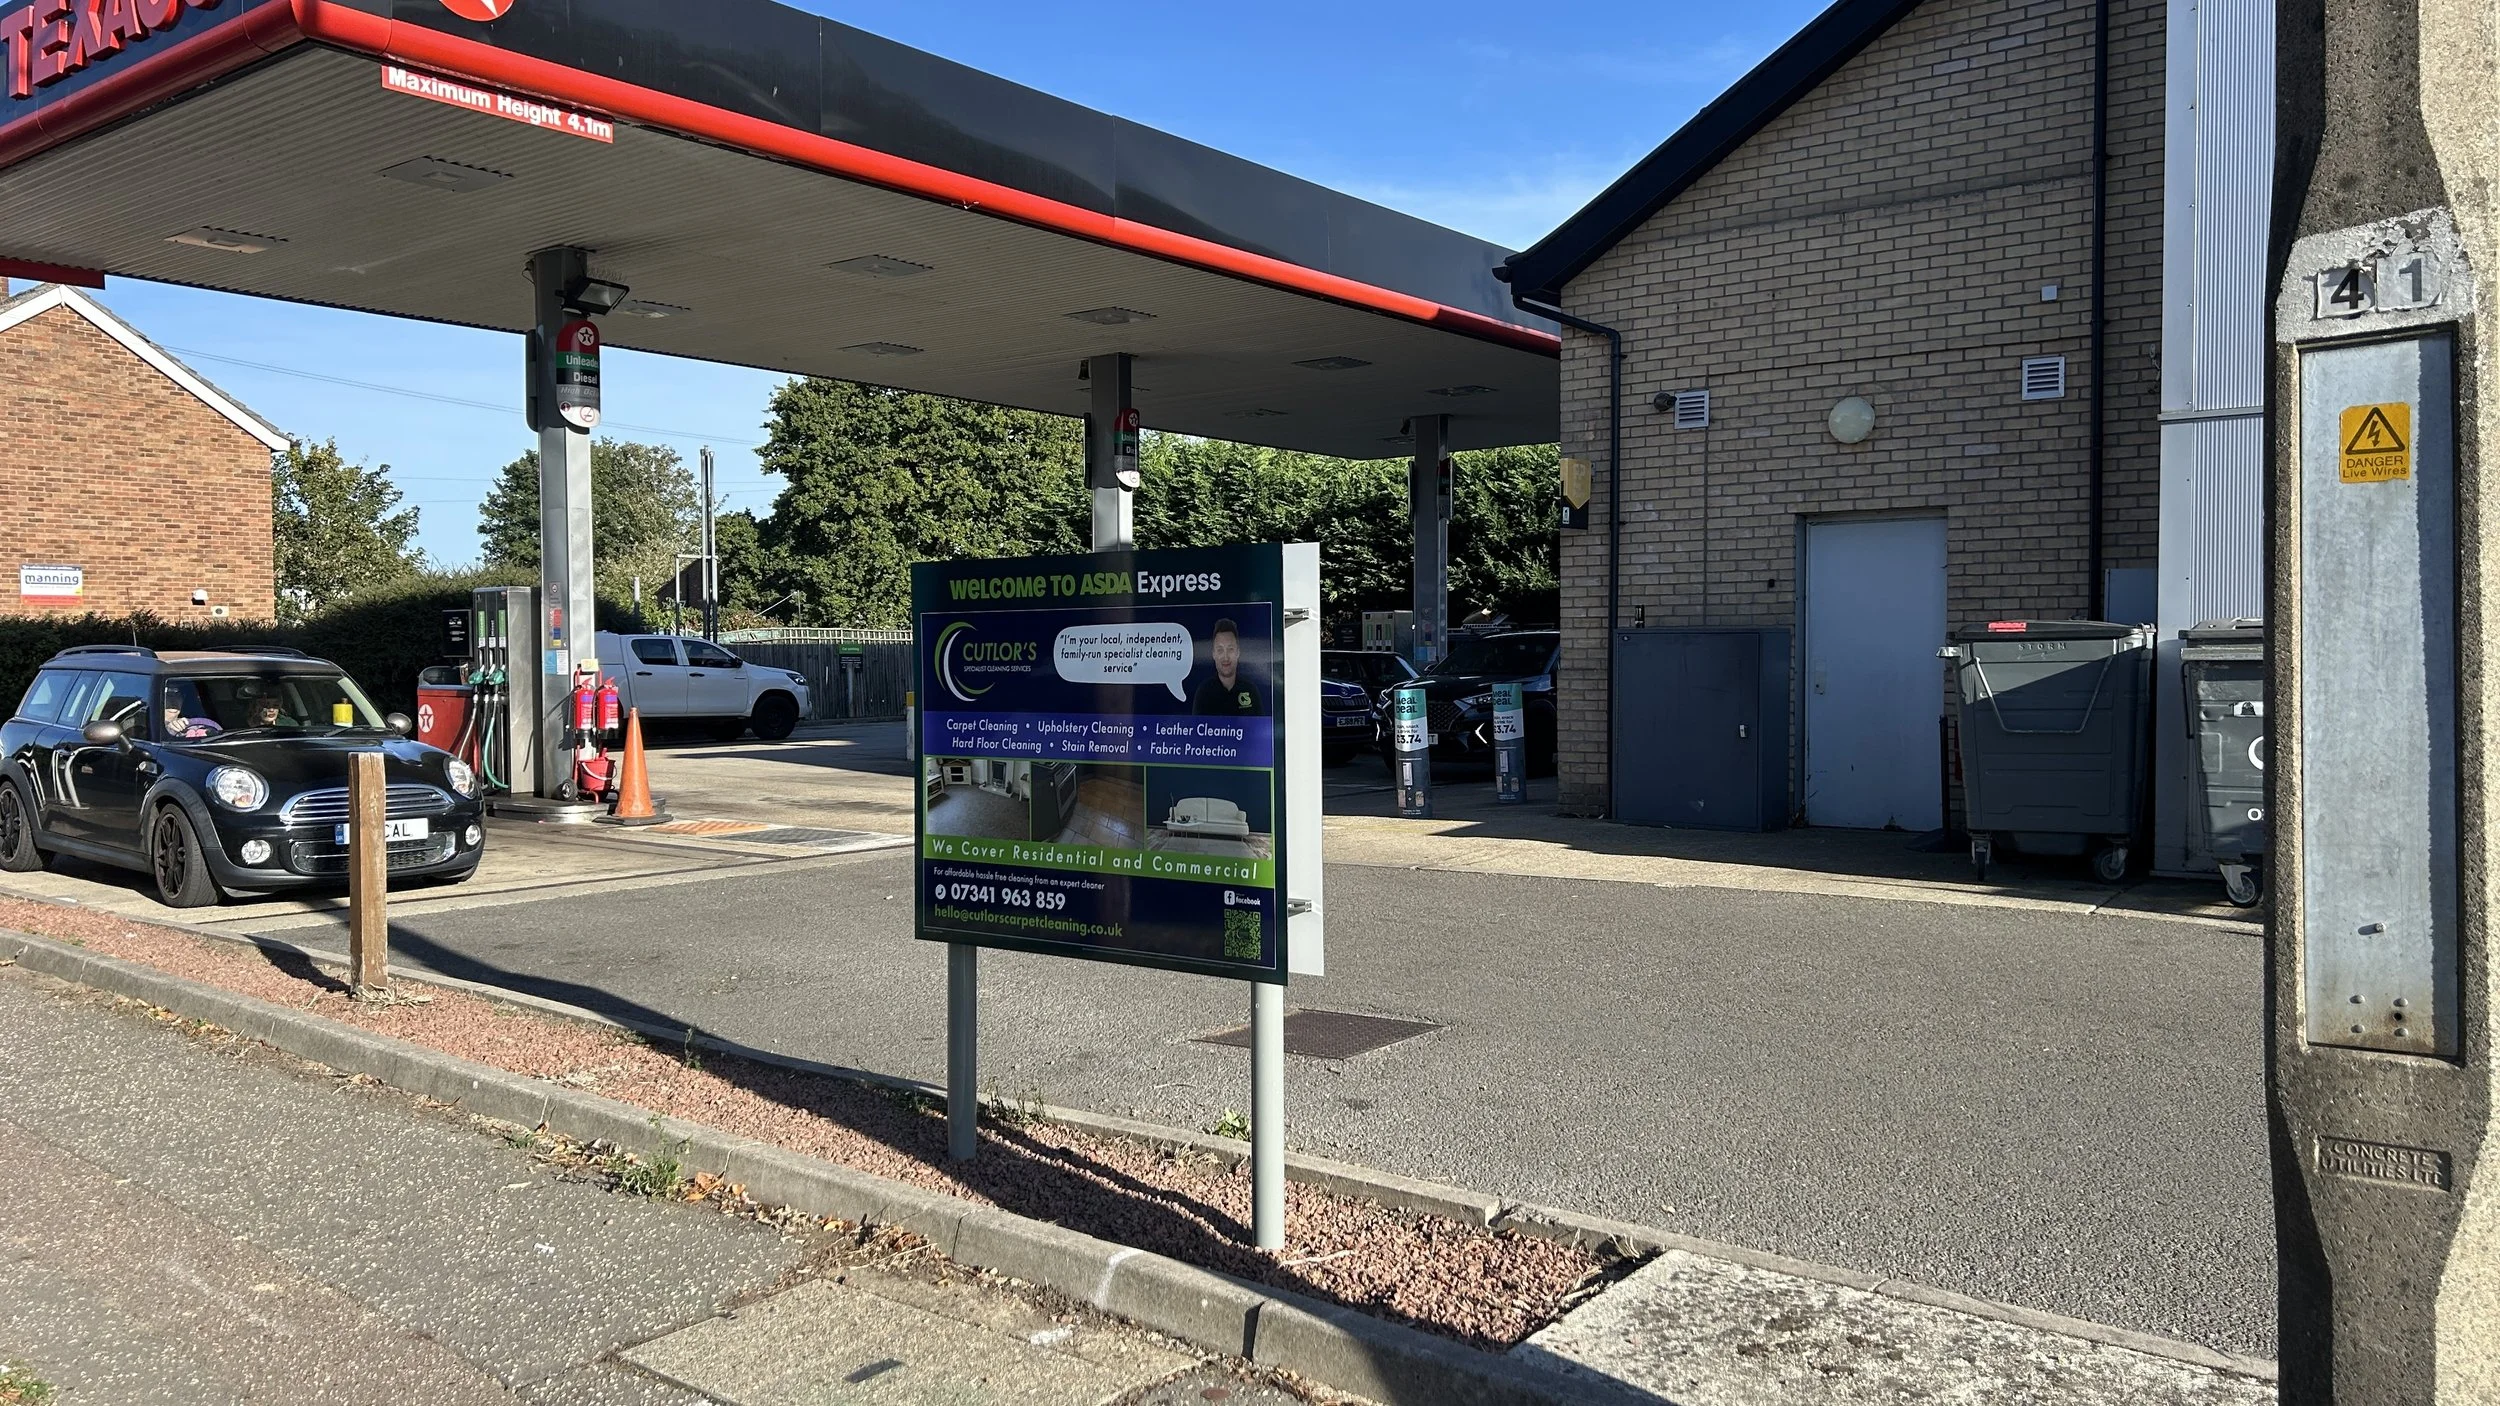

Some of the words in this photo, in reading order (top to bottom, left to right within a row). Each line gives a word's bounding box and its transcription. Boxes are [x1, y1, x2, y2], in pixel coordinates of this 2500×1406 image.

[0, 0, 222, 100] TEXA
[388, 66, 491, 109] Maximum
[497, 94, 561, 126] Height
[567, 113, 611, 139] 4.1m
[573, 371, 597, 384] Diesel
[2346, 455, 2404, 469] DANGER
[2343, 469, 2367, 478] Live
[2371, 466, 2407, 476] Wires
[25, 572, 79, 586] manning
[1050, 574, 1076, 597] TO
[1080, 572, 1133, 595] ASDA
[1137, 571, 1221, 598] Express
[1079, 636, 1098, 648] your
[1100, 633, 1123, 646] local,
[1126, 632, 1183, 647] independent,
[2018, 642, 2067, 650] STORM
[963, 641, 1037, 661] CUTLOR'S
[1061, 648, 1102, 661] family-run
[1104, 647, 1143, 660] specialist
[1145, 647, 1182, 661] cleaning
[946, 718, 977, 733] Carpet
[979, 719, 1018, 735] Cleaning
[1037, 720, 1089, 737] Upholstery
[1091, 721, 1134, 738] Cleaning
[1156, 722, 1193, 736] Leather
[1197, 723, 1243, 741] Cleaning
[952, 737, 974, 749] Hard
[977, 737, 999, 749] Floor
[1002, 737, 1042, 754] Cleaning
[1062, 739, 1085, 752] Stain
[1088, 740, 1129, 753] Removal
[1150, 742, 1181, 755] Fabric
[1184, 743, 1237, 757] Protection
[932, 838, 953, 854] We
[961, 841, 1004, 858] Cover
[1013, 845, 1104, 867] Residential
[1112, 853, 1143, 870] and
[1152, 855, 1258, 880] Commercial
[933, 866, 944, 876] For
[944, 867, 975, 879] affordable
[976, 869, 994, 880] hassle
[994, 871, 1007, 881] free
[1008, 873, 1033, 886] cleaning
[1034, 874, 1049, 885] from
[1060, 880, 1080, 889] expert
[1081, 879, 1105, 890] cleaner
[950, 883, 995, 903] 07341
[1001, 887, 1031, 907] 963
[1036, 890, 1066, 910] 859
[1236, 895, 1260, 906] facebook
[934, 903, 1123, 937] hello@cutlorscarpetcleaning.co.uk
